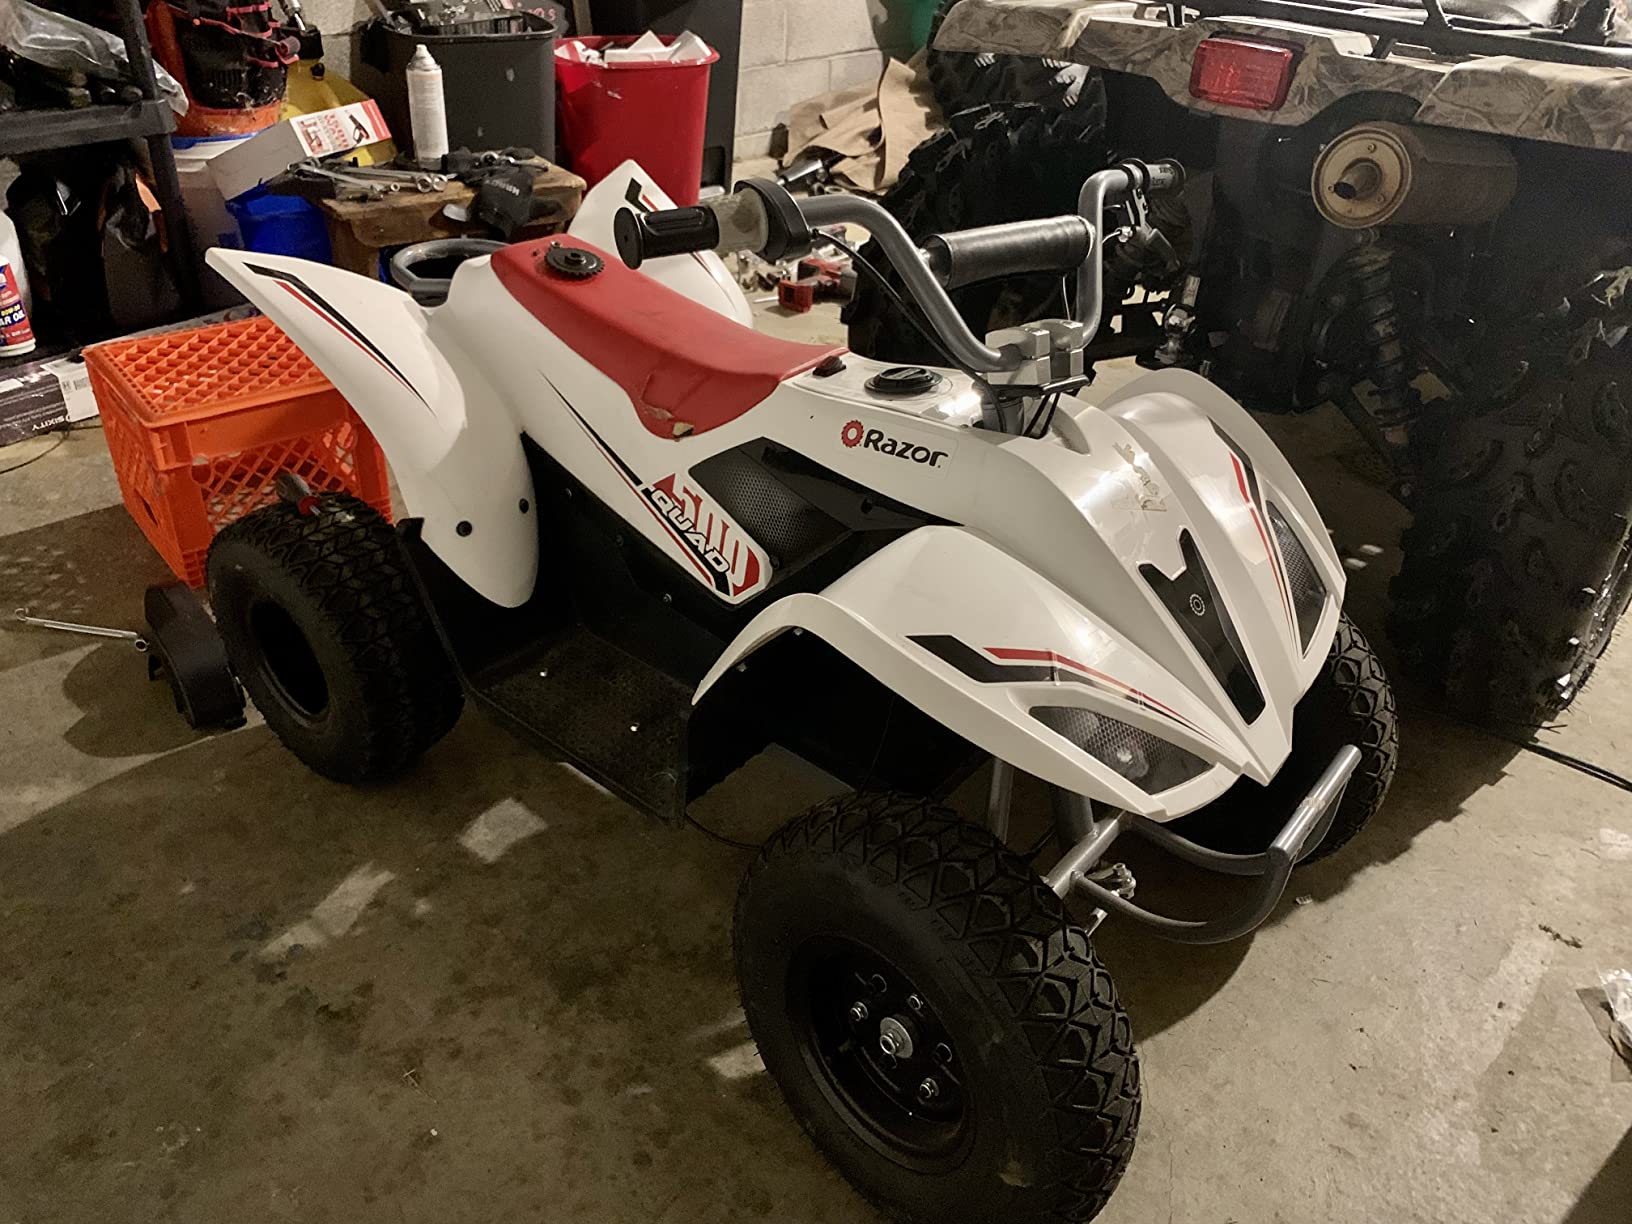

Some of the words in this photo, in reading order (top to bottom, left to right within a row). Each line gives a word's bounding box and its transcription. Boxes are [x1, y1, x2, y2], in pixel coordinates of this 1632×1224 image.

[32, 415, 65, 431] SIXITY
[863, 428, 949, 468] Razor
[650, 487, 731, 573] QUAD
